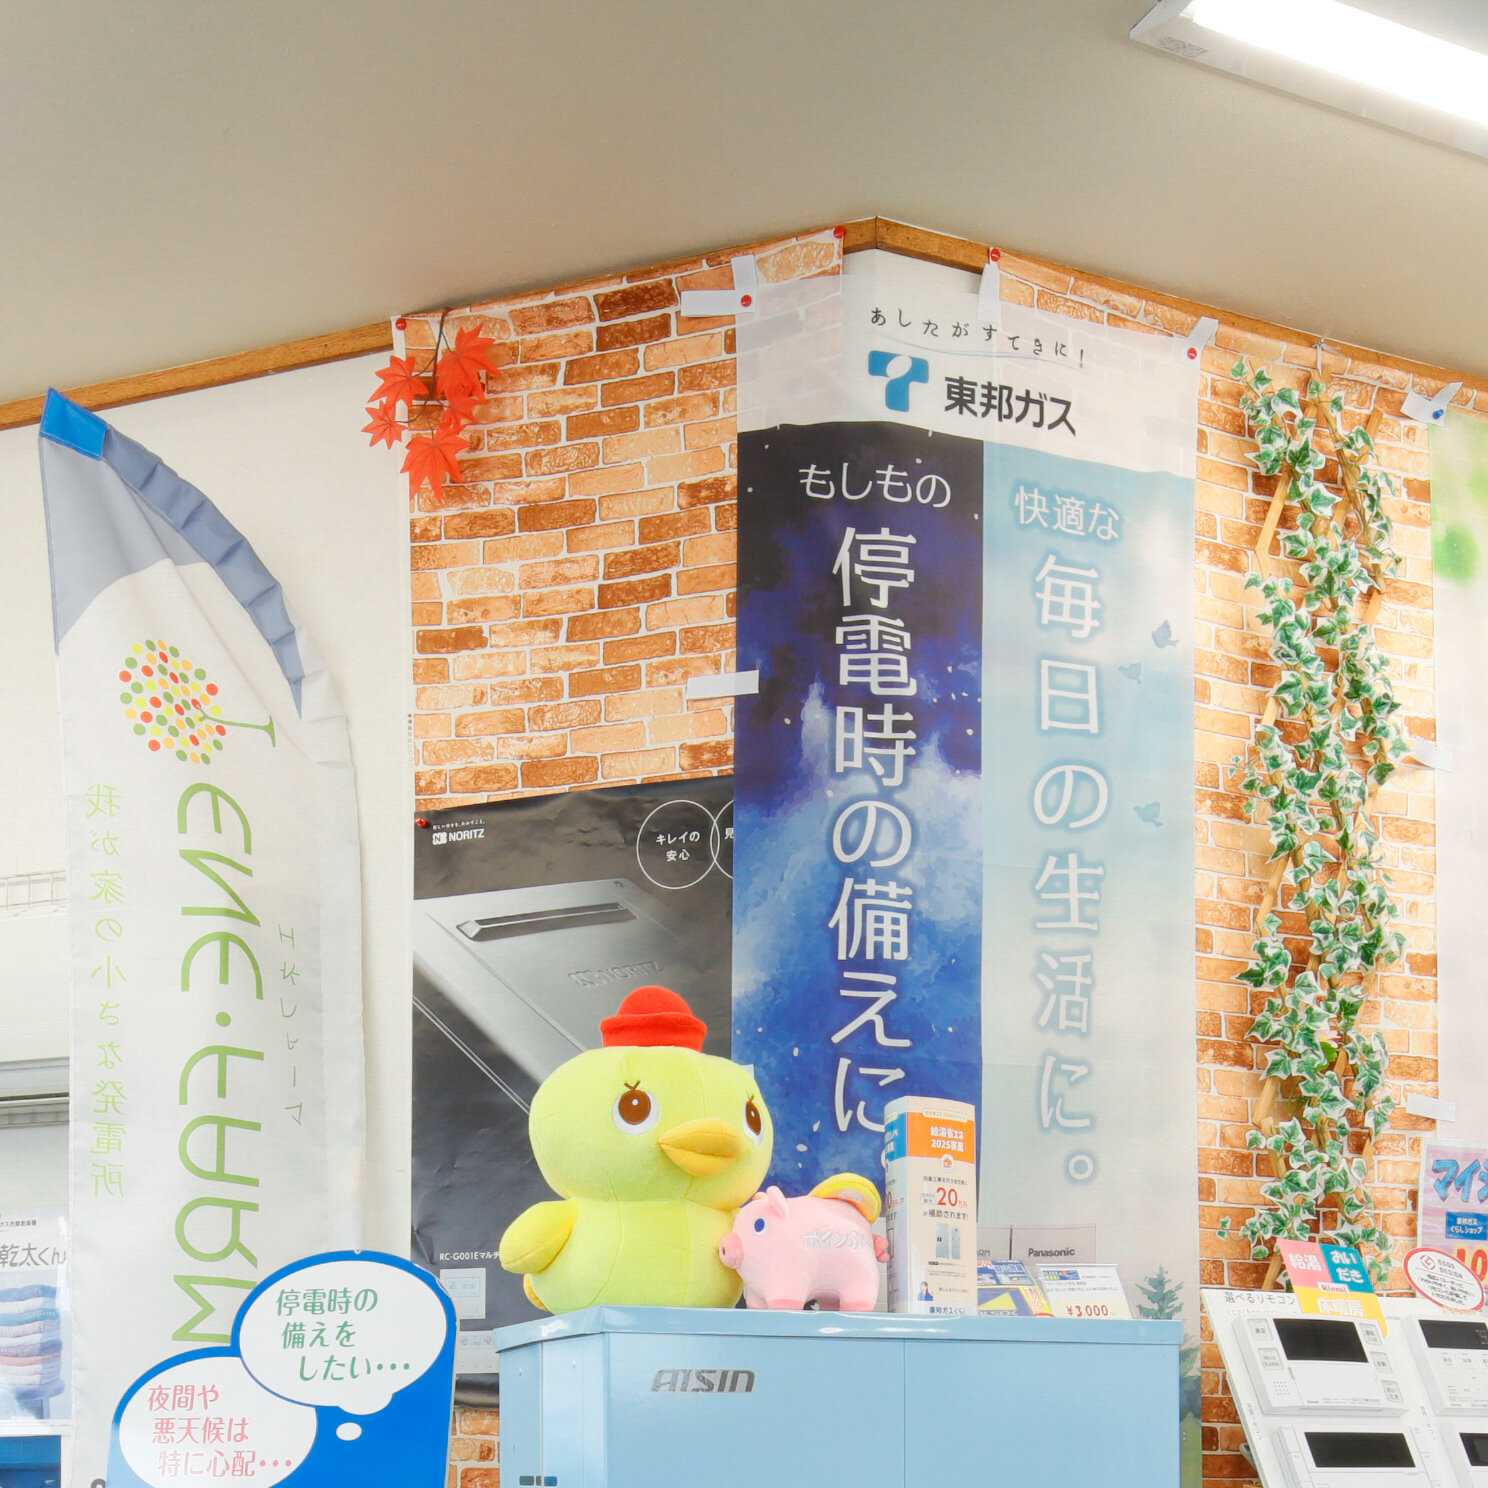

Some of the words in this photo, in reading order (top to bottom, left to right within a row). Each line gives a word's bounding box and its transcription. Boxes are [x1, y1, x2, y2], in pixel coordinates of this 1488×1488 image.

[869, 305, 1085, 368] あしたがすてきに!
[943, 374, 1077, 436] 東邦ガス
[798, 463, 952, 508] もしもの
[1014, 485, 1120, 542] 快適な
[448, 829, 484, 842] NORITZ
[656, 831, 700, 845] キレイの
[828, 526, 917, 1140] 停電時の備えに
[666, 849, 690, 862] 安心
[1032, 554, 1112, 1182] 毎日の生活に。
[930, 1126, 964, 1140] 給湯省エネ
[931, 1139, 964, 1152] 2025事業
[1028, 1248, 1075, 1257] Panasonic
[276, 1288, 377, 1317] 停電時の
[1225, 1292, 1296, 1305] 選べるリモコン
[282, 1322, 356, 1350] 備えを
[651, 1369, 755, 1393] AISIN
[147, 1384, 219, 1412] 夜間や
[152, 1417, 249, 1444] 悪天候は
